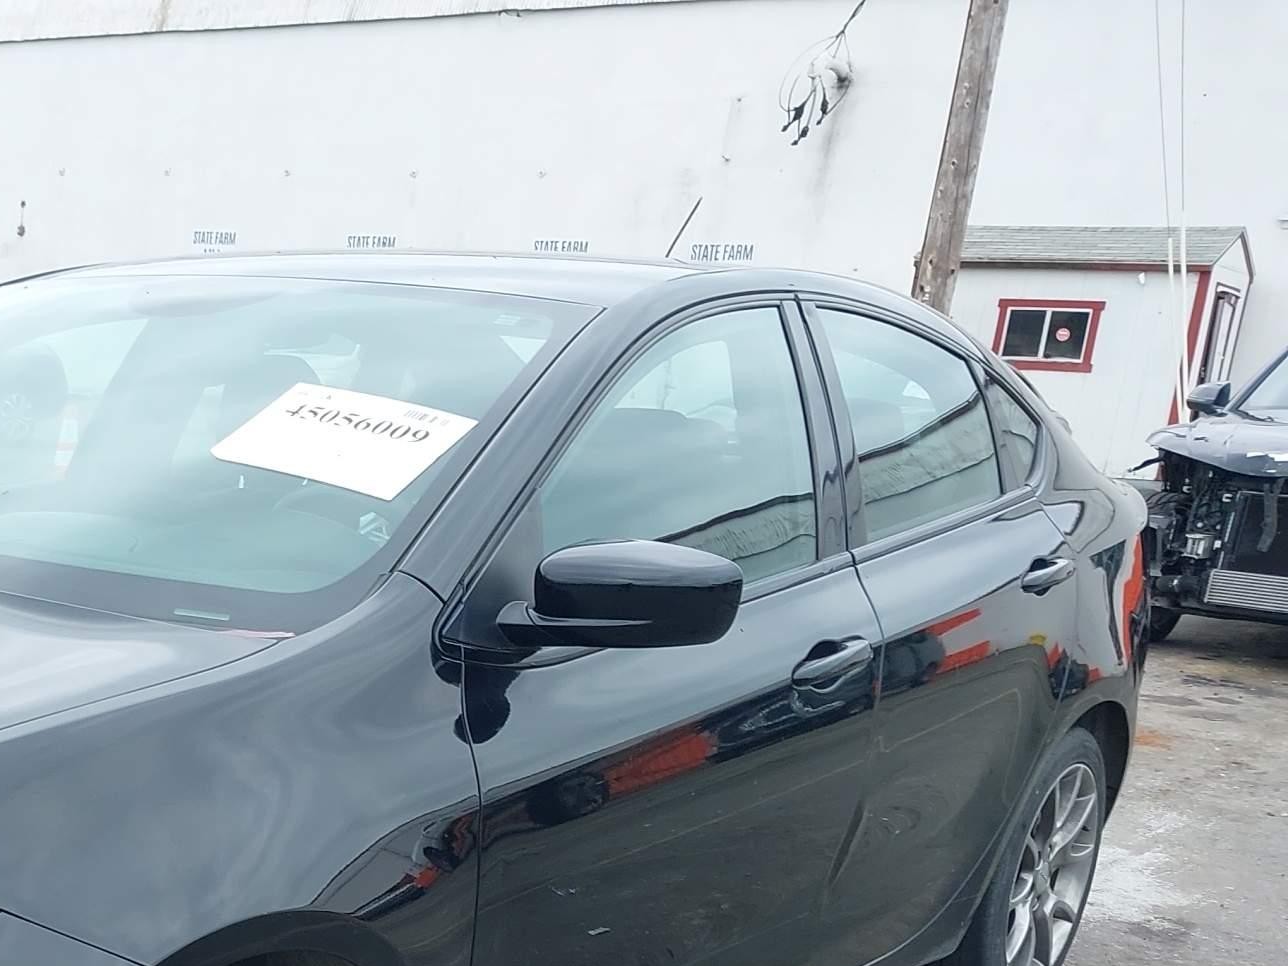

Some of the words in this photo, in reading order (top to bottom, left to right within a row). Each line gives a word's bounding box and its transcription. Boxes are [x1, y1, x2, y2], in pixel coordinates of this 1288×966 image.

[193, 231, 214, 244] STATE
[215, 232, 237, 245] FARM
[347, 235, 370, 249] STATE
[372, 236, 397, 249] FARM
[534, 240, 559, 252] STATE
[561, 241, 589, 254] FARM
[691, 244, 721, 261] STATE
[722, 244, 754, 261] FARM
[285, 404, 430, 443] 45056009
